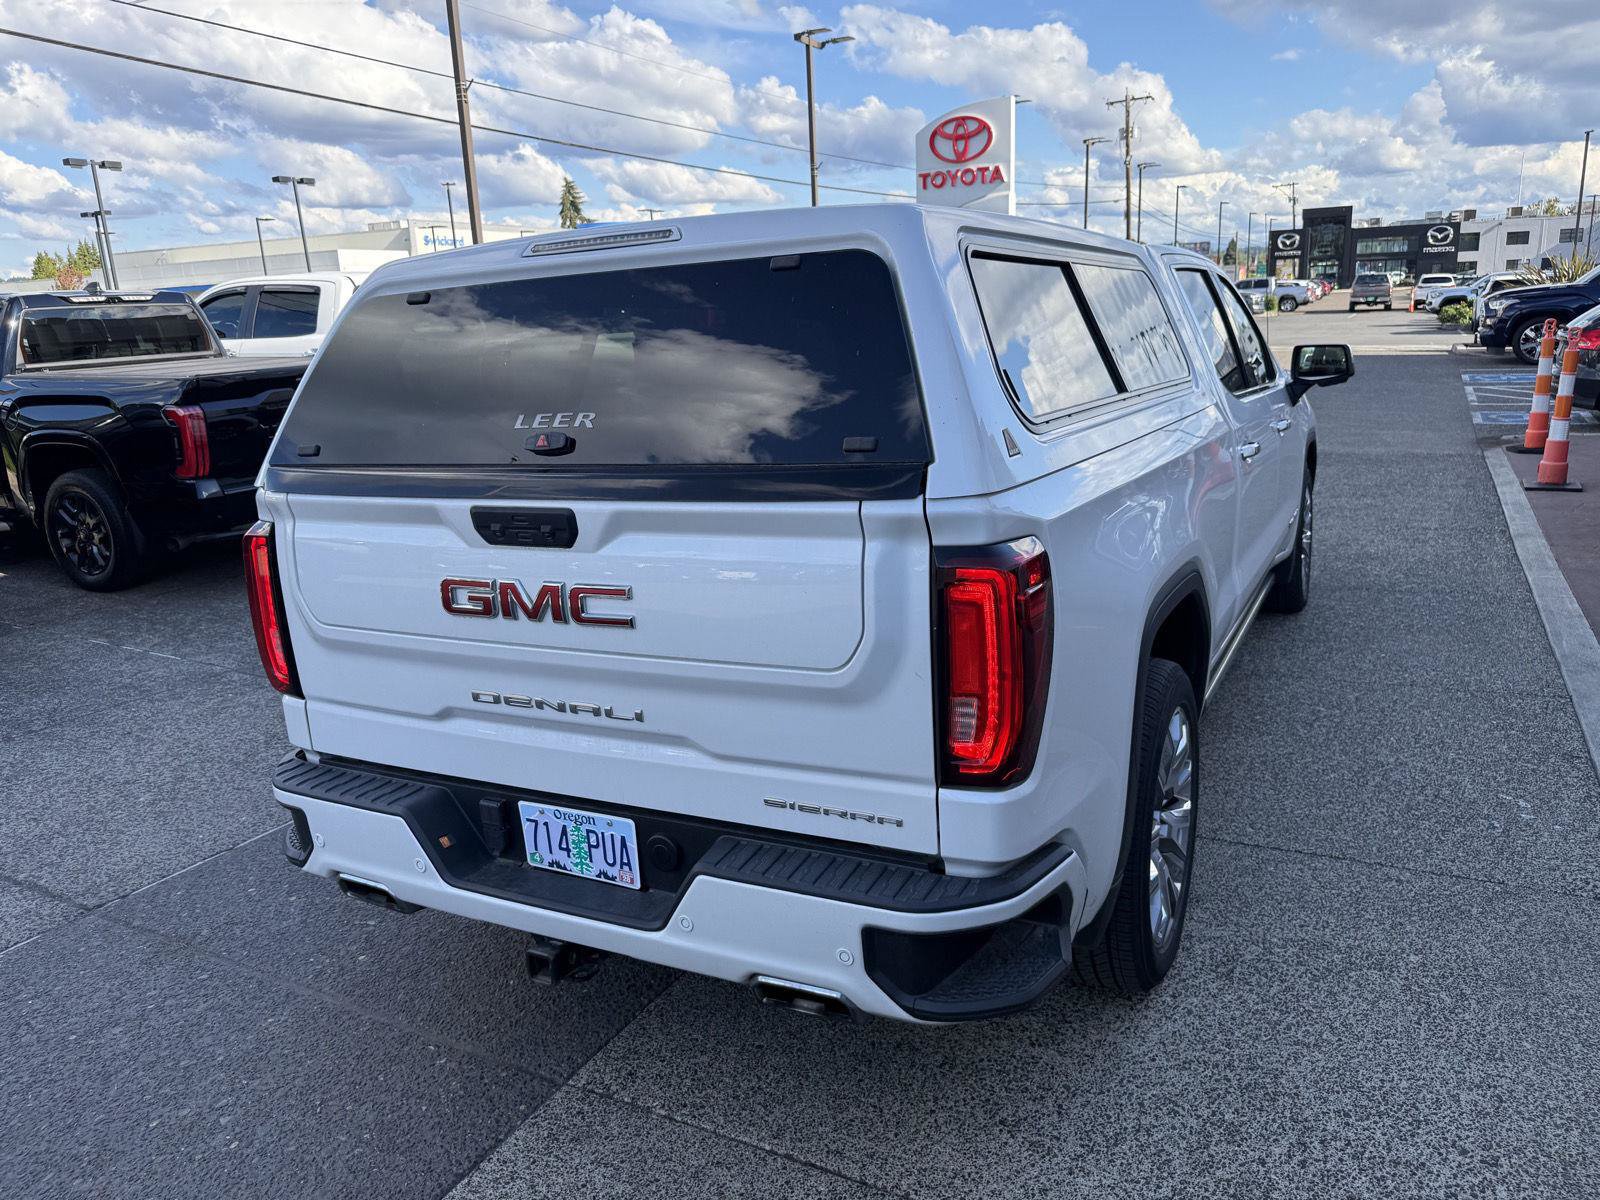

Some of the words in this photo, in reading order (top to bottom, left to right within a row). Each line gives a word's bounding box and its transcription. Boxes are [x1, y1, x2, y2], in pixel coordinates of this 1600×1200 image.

[918, 165, 1006, 190] TOYOTA
[514, 412, 596, 429] LEER
[440, 575, 636, 629] GMC
[471, 690, 645, 722] DENALI
[553, 808, 597, 826] Oregon
[763, 797, 904, 827] SIERRA
[525, 817, 572, 859] 714
[585, 828, 633, 872] PUA
